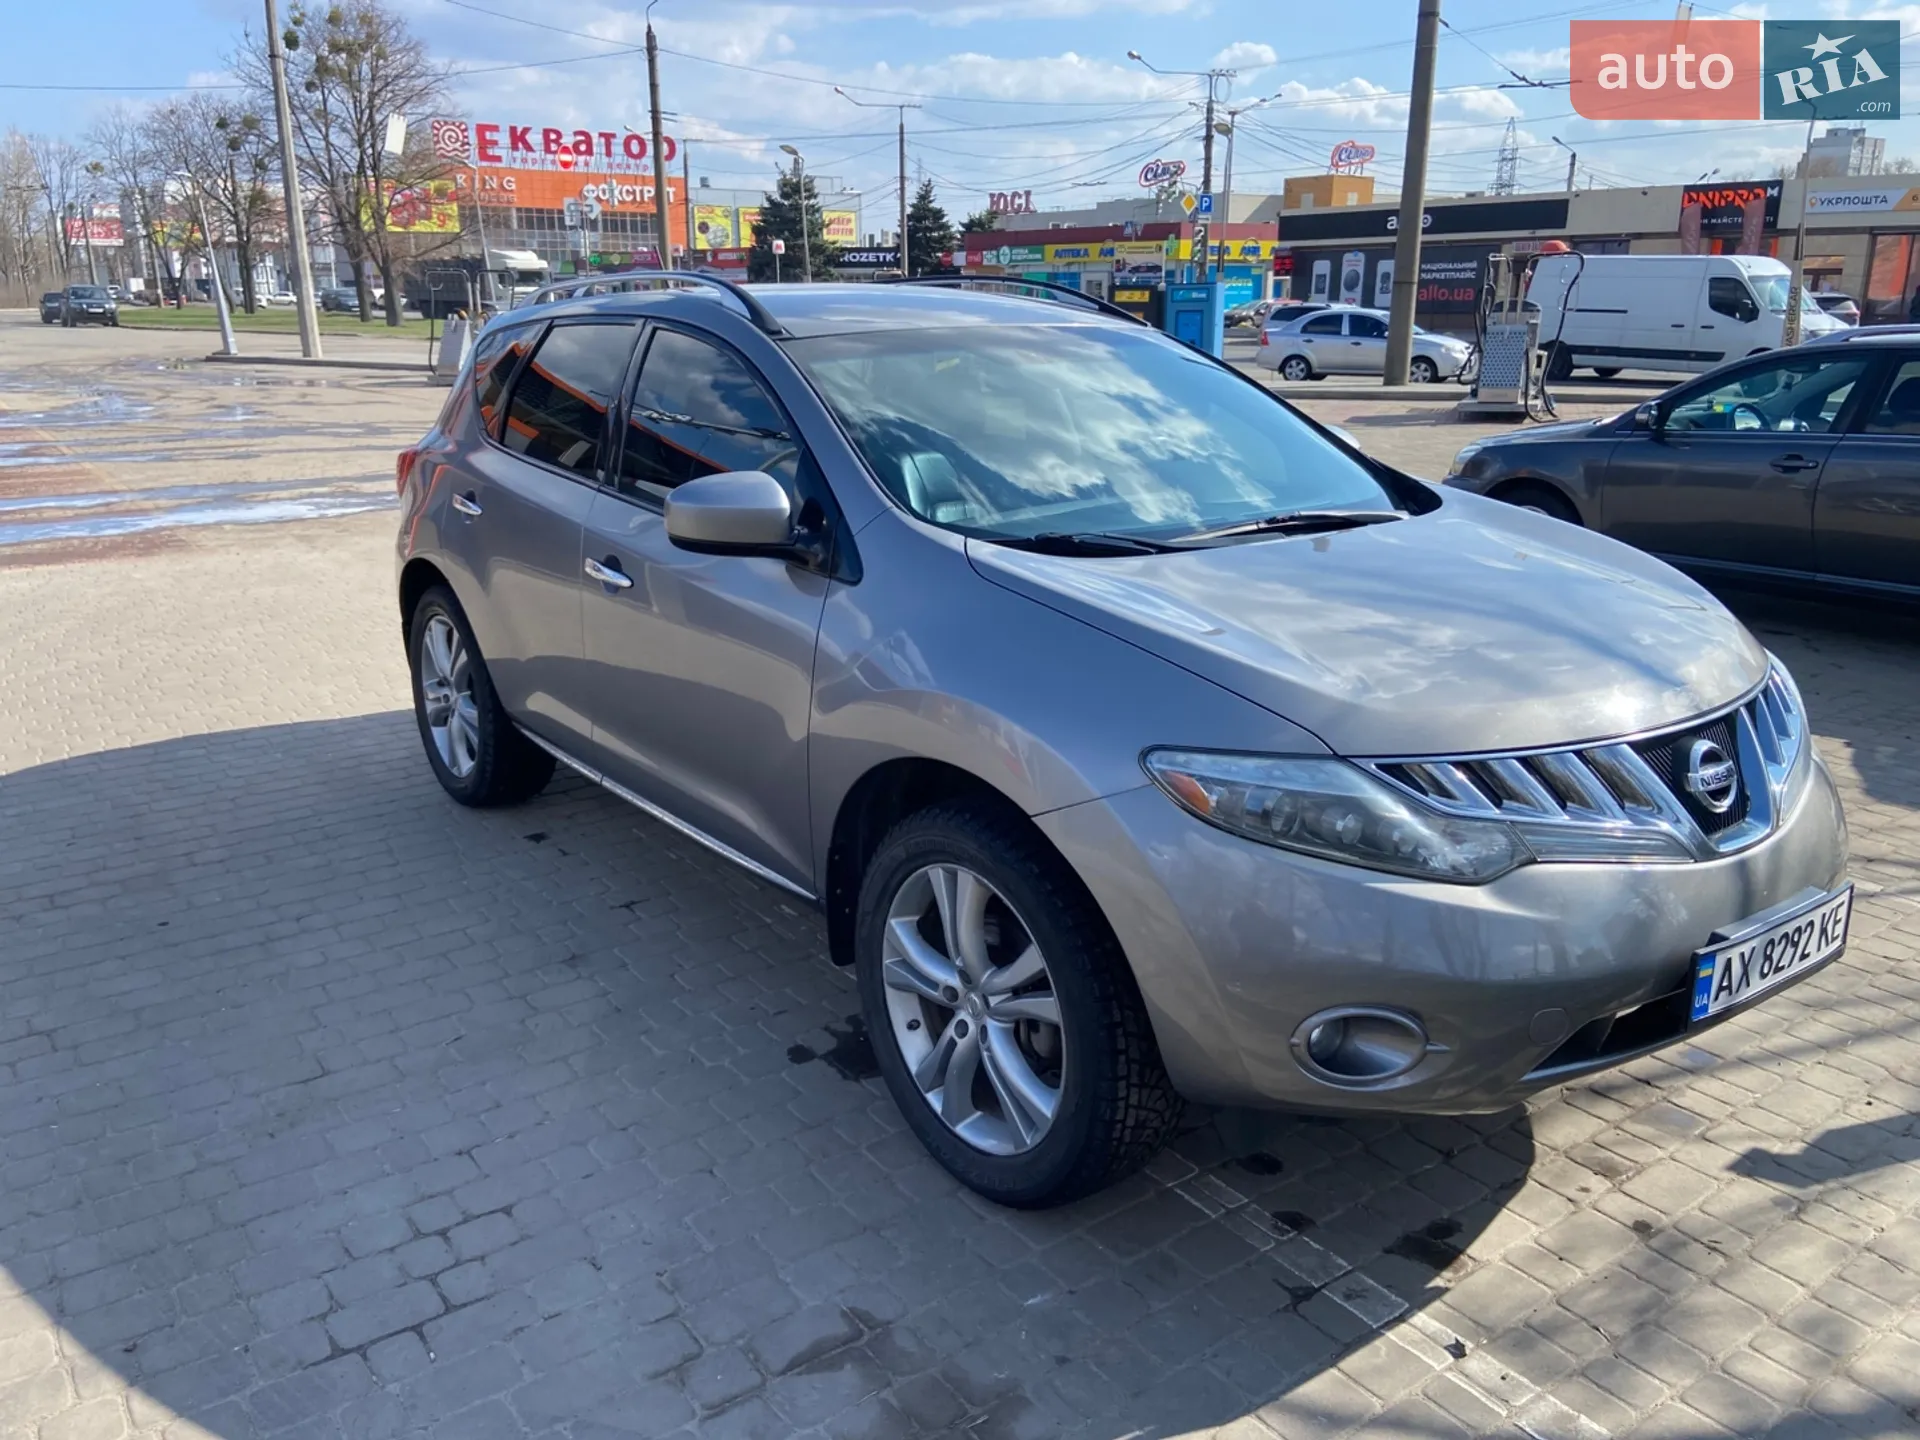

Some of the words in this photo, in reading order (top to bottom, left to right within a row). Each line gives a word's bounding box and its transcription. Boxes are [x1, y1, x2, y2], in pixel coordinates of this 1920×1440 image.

[583, 181, 677, 203] ФОКСТРТ
[1202, 197, 1210, 211] P
[1817, 194, 1888, 207] УКРПОШТА
[1386, 213, 1432, 231] ao
[840, 251, 901, 263] ROZETK
[1420, 260, 1478, 270] НАЦІОНАЛЬНИЙ
[1419, 269, 1477, 280] МАРКЕТПЛЕЙС
[1418, 283, 1475, 301] allo.ua
[1713, 944, 1756, 1002] AX
[1759, 919, 1815, 981] 8292
[1817, 900, 1845, 952] KE
[1695, 992, 1708, 1008] UA
